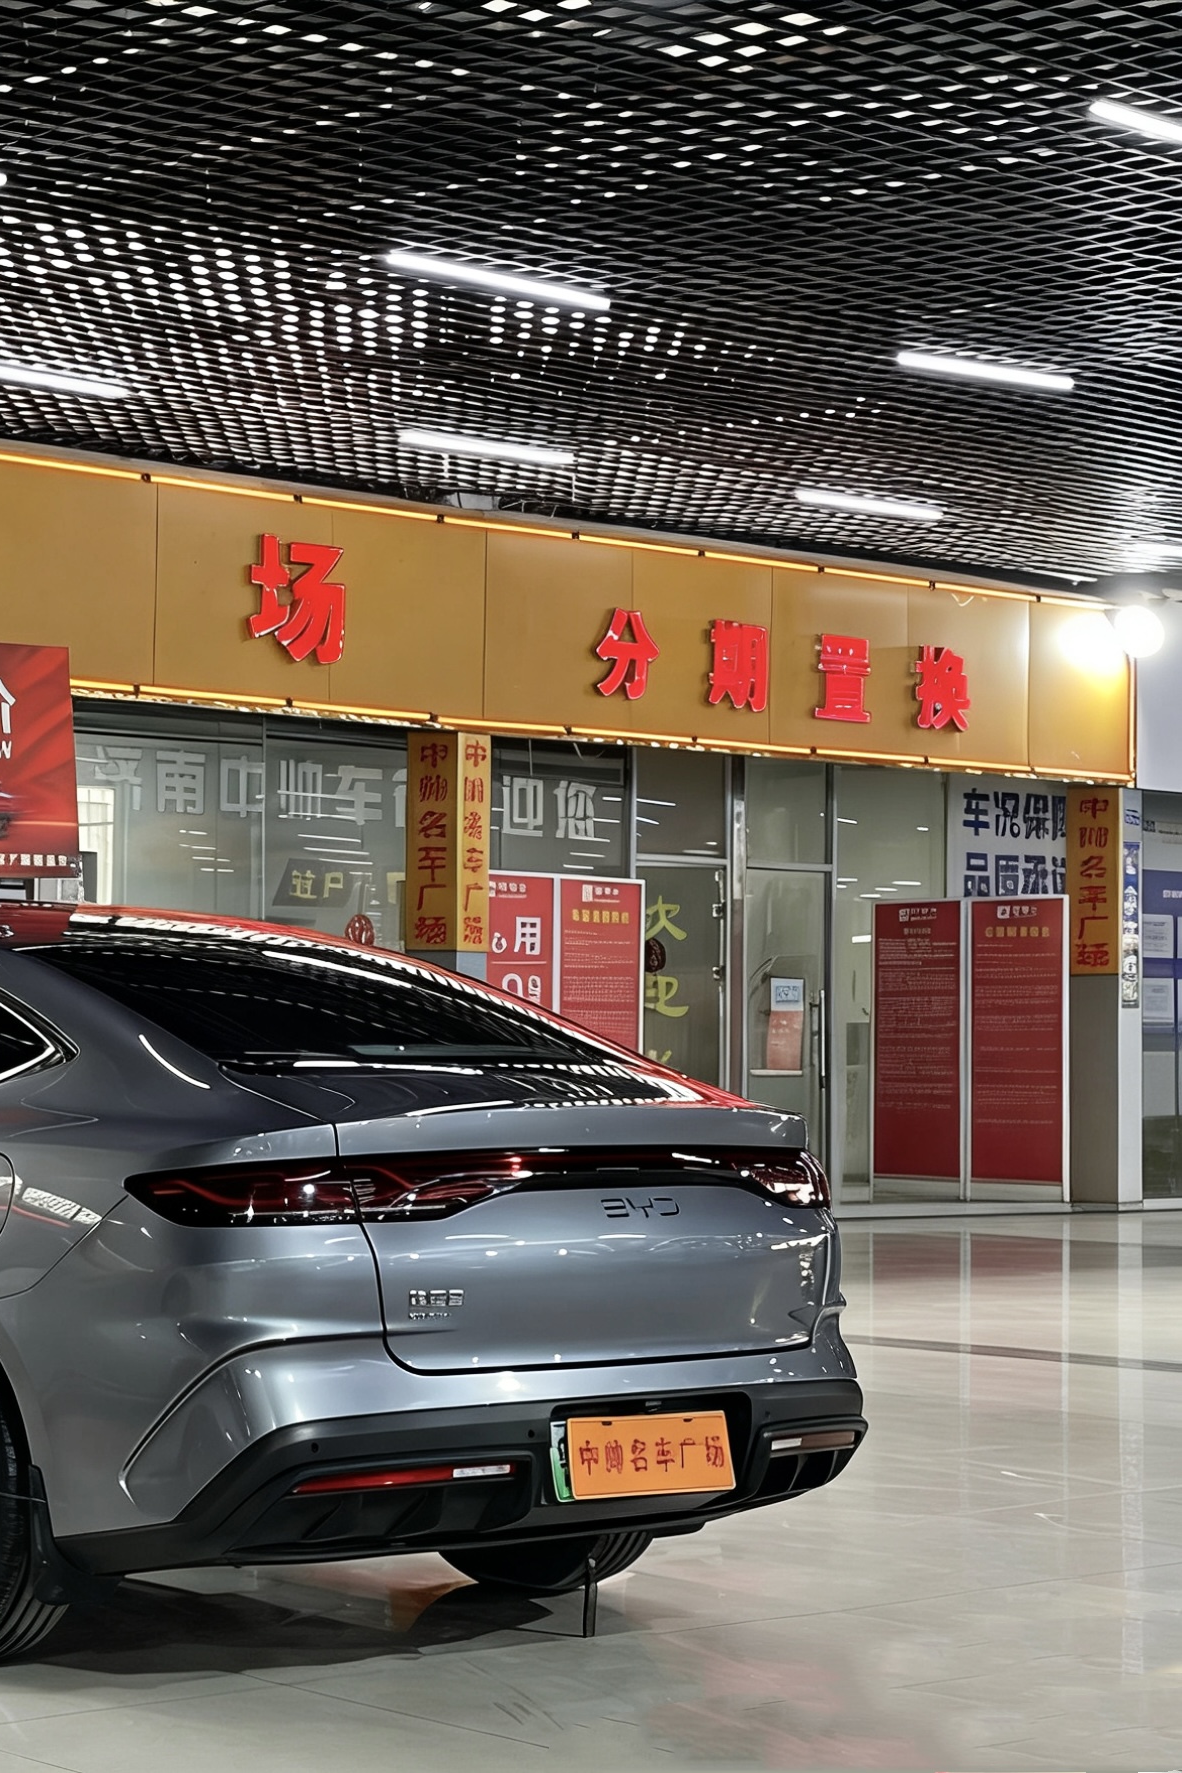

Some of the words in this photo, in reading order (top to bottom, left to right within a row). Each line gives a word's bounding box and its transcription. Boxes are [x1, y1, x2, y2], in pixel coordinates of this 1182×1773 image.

[596, 606, 971, 732] 分期置换
[600, 1197, 680, 1219] BYD
